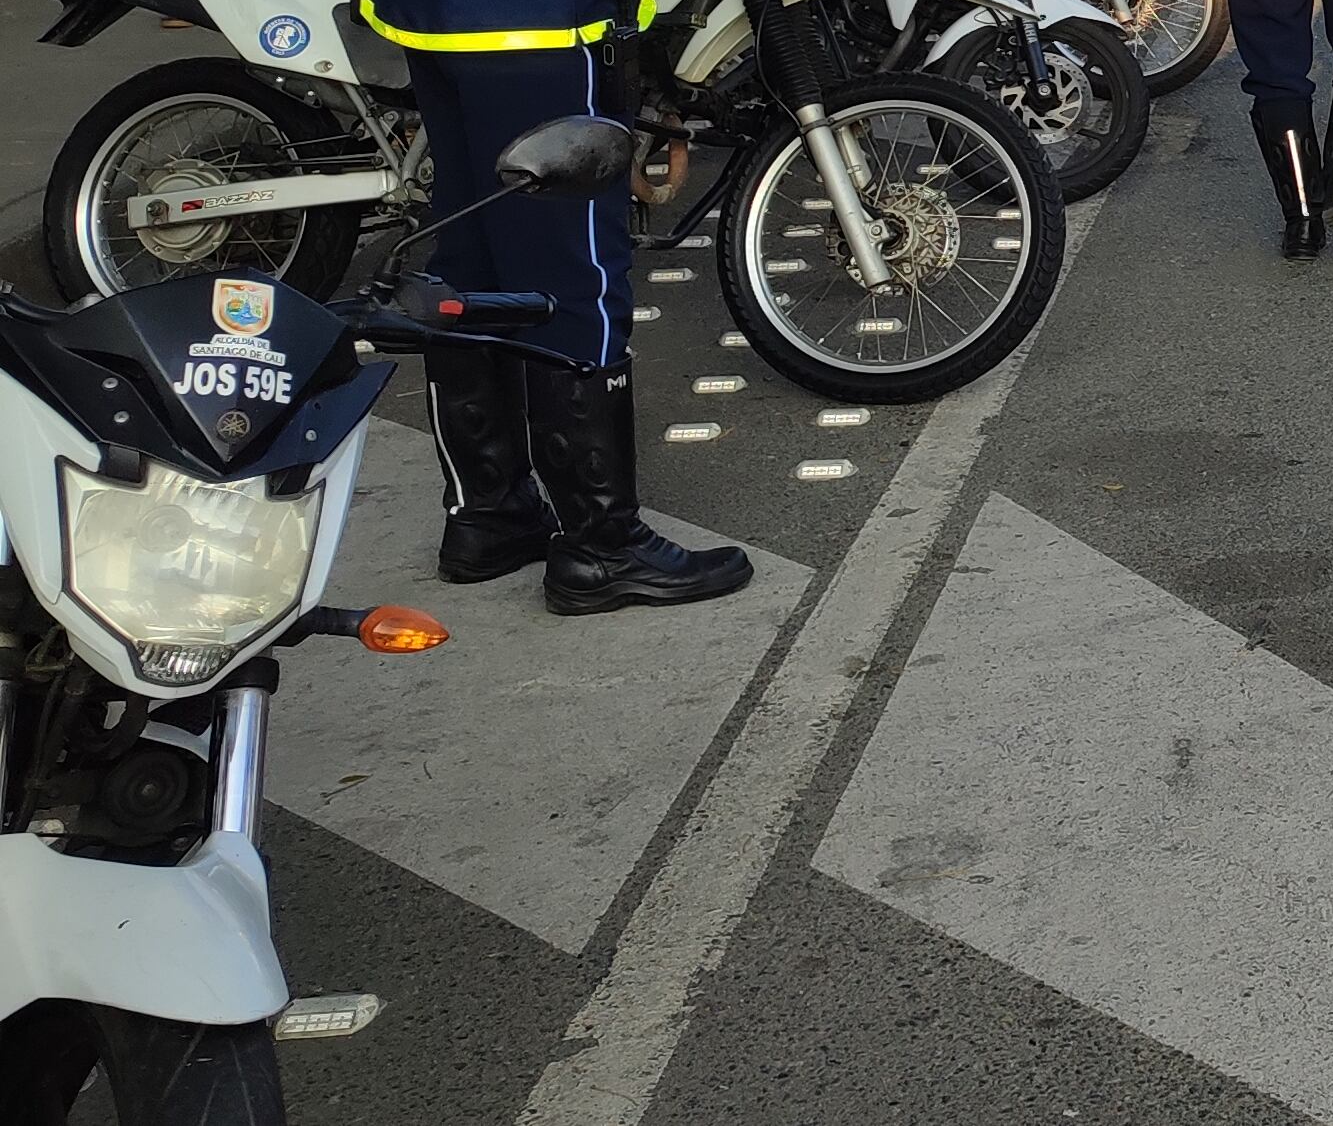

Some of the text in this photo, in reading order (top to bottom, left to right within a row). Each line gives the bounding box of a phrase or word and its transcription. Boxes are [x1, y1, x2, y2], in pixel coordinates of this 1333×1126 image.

[204, 191, 273, 208] BAZZAZ
[257, 340, 269, 350] DE
[192, 345, 284, 364] SANTIAGO DE CALI
[173, 362, 292, 404] JOS 59E
